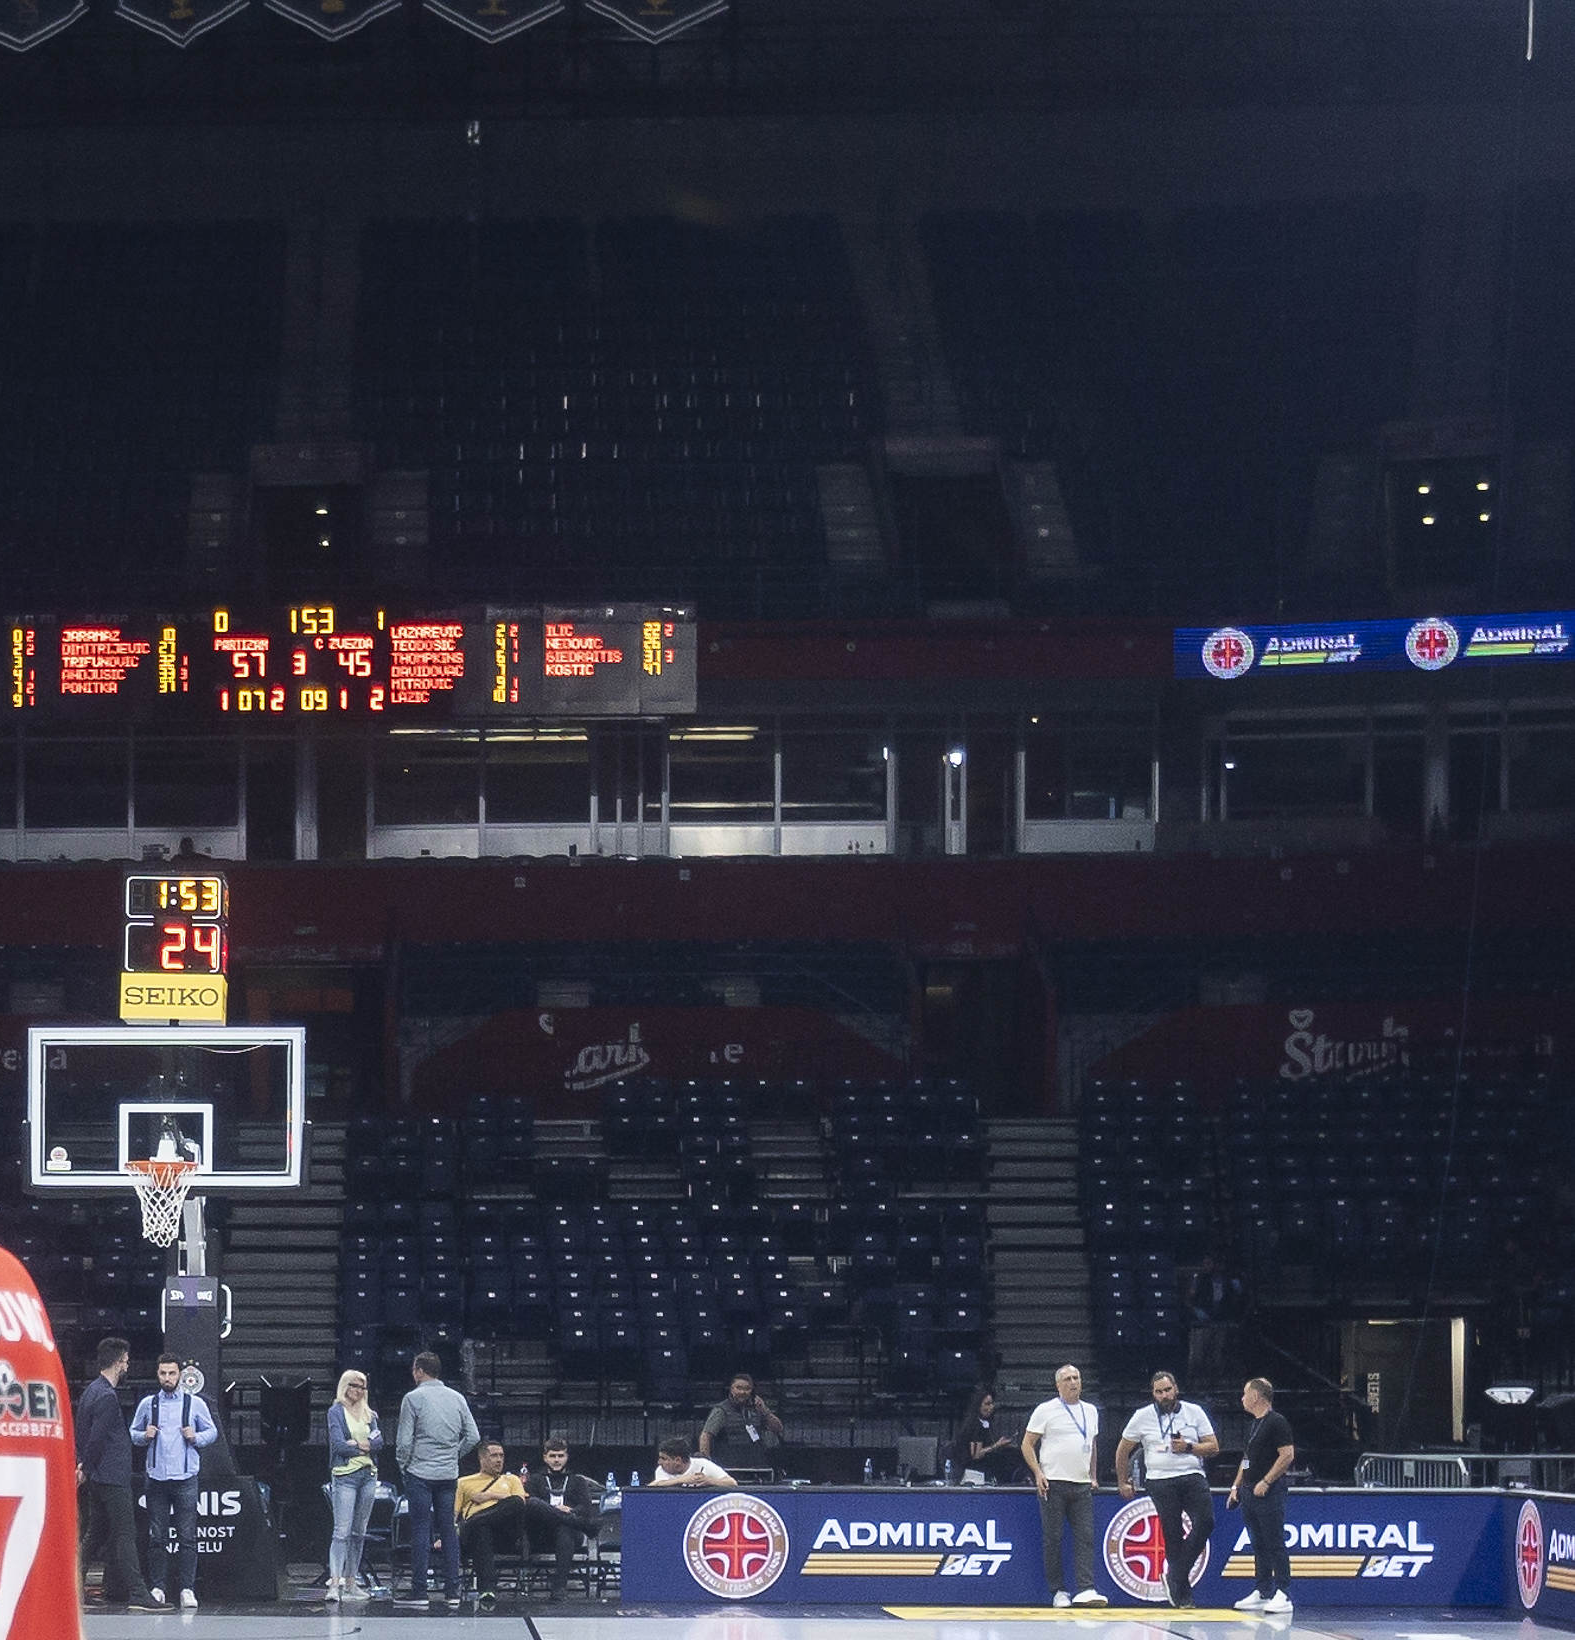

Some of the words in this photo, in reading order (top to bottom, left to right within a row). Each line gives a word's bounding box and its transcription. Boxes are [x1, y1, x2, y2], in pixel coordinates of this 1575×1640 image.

[214, 611, 229, 633] 0
[377, 611, 384, 631] 1
[545, 623, 574, 637] ILIC
[390, 625, 464, 639] LAZAREVIC
[61, 642, 150, 655] DIMITRIJEVIC
[214, 638, 269, 651] PARTIZAN
[314, 637, 325, 650] C
[328, 637, 374, 650] ZVEZDA
[545, 637, 603, 650] NEDOVIC
[61, 655, 139, 668] TRIFUNOVIC
[232, 651, 266, 678] 57
[292, 651, 307, 675] 3
[338, 651, 372, 677] 45
[545, 664, 595, 676] KOSTIC
[221, 690, 229, 711] 1
[238, 689, 266, 711] 07
[270, 688, 284, 711] 2
[301, 689, 328, 711] 09
[340, 689, 348, 710] 1
[370, 689, 384, 711] 2
[391, 690, 431, 703] LAZIC
[160, 881, 218, 911] 1:53
[161, 928, 217, 969] 24
[124, 986, 219, 1006] SEIKO
[812, 1518, 1013, 1550] ADMIRAL
[197, 1541, 222, 1553] ELU
[941, 1553, 1012, 1576] BET
[1362, 1554, 1433, 1578] BET
